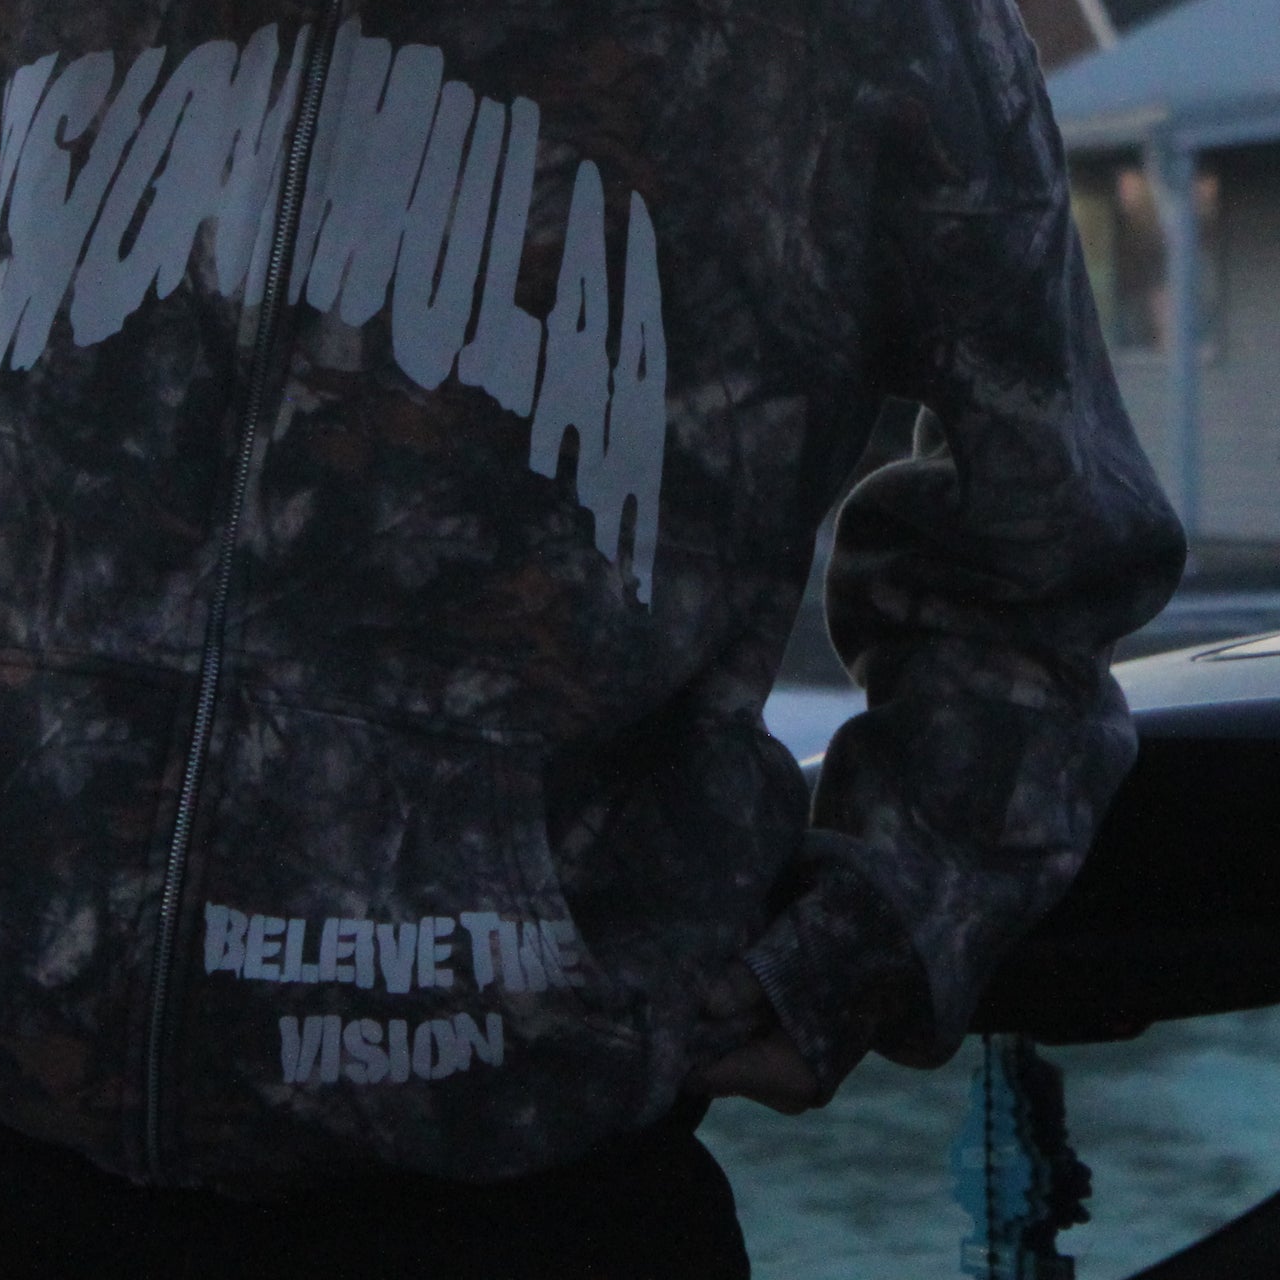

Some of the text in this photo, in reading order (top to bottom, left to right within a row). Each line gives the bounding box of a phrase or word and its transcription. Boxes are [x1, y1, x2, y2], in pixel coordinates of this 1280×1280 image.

[288, 20, 667, 613] MULAA
[204, 901, 586, 993] BELEIVE THE
[278, 1012, 504, 1084] VISION
